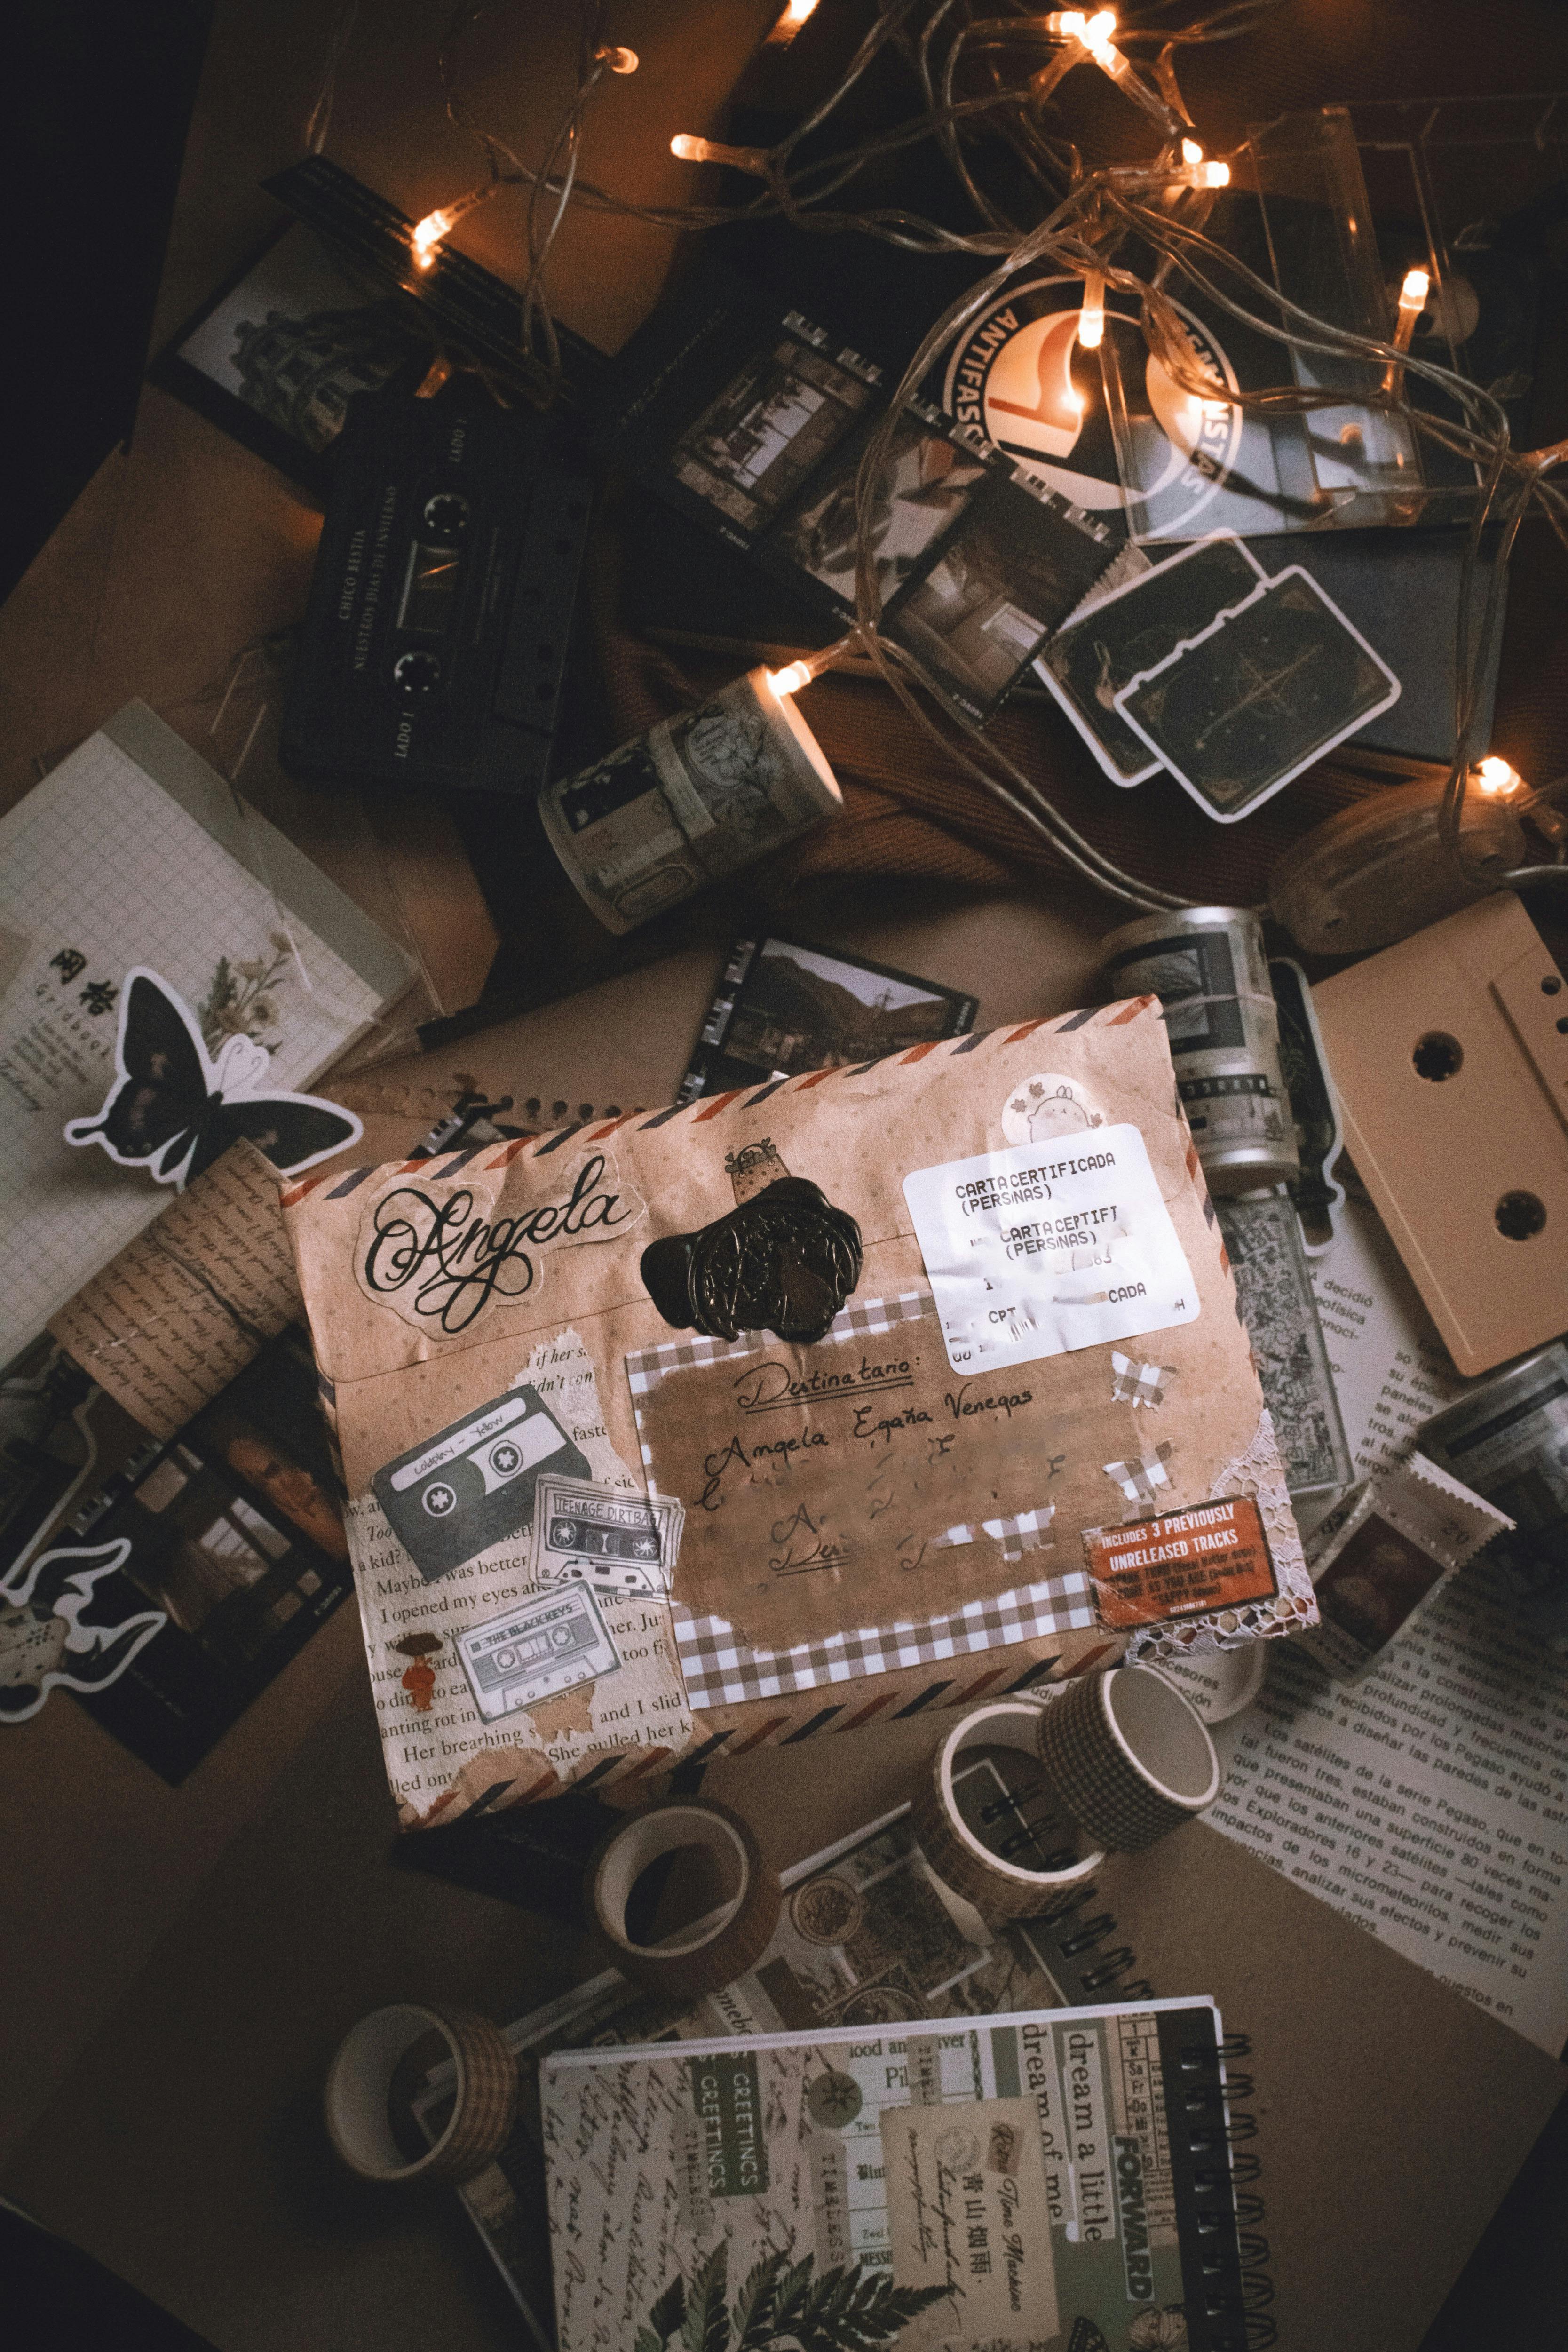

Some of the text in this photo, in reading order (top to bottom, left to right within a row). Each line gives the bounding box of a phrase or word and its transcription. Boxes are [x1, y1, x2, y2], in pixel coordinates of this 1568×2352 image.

[954, 1151, 1116, 1200] CARTA CERTIFICADA
[364, 1154, 632, 1335] Angela
[999, 1219, 1053, 1245] CARTA
[1108, 1282, 1147, 1303] CADA
[547, 1344, 576, 1364] her
[1379, 1384, 1435, 1414] paneles
[704, 1427, 829, 1478] Angela
[366, 1522, 393, 1542] Too
[554, 1496, 605, 1518] TEENAGE
[1101, 1503, 1236, 1549] INCLUDES 3 PREVIOUSLY
[369, 1549, 402, 1570] kid?
[445, 1565, 475, 1582] was
[477, 1549, 529, 1576] better
[1109, 1540, 1189, 1572] UNRELEASED
[1192, 1528, 1239, 1553] TRACKS
[391, 1595, 450, 1626] opened
[453, 1594, 478, 1613] my
[481, 1585, 519, 1607] eyes
[622, 1645, 649, 1662] too
[434, 1714, 457, 1729] rot
[598, 1703, 631, 1724] and
[650, 1692, 681, 1711] slid
[1362, 1680, 1568, 1784] profundidad frecuencia de
[1419, 1686, 1507, 1737] prolongadas
[402, 1724, 523, 1764] Her breathing
[548, 1742, 581, 1763] She
[646, 1721, 676, 1740] her
[1335, 1690, 1553, 1799] recibidos por los Pegaso ayudó
[1352, 1718, 1540, 1812] diseñar las paredes de las
[1239, 1733, 1260, 1751] tal
[1264, 1744, 1310, 1774] fueron
[1350, 1781, 1408, 1818] estaban
[1411, 1809, 1494, 1856] construidos
[1496, 1849, 1517, 1866] en
[1521, 1859, 1563, 1887] forma
[1262, 1723, 1290, 1744] Los
[1292, 1734, 1353, 1772] satélites
[1354, 1764, 1375, 1781] de
[1378, 1774, 1393, 1789] la
[1395, 1781, 1433, 1808] serie
[1493, 1827, 1524, 1850] que
[1526, 1841, 1545, 1858] en
[1225, 1771, 1248, 1790] yor
[1253, 1783, 1283, 1806] que
[1287, 1797, 1310, 1816] los
[1313, 1809, 1385, 1851] anteriores
[1390, 1842, 1449, 1879] satélites
[1508, 1897, 1550, 1924] como
[1231, 1752, 1556, 1906] que presentaban una superficie 80 veces ma-
[1209, 1805, 1275, 1846] impactos
[1281, 1837, 1302, 1855] de
[1308, 1849, 1332, 1868] los
[1460, 1918, 1504, 1946] medir
[1509, 1941, 1536, 1961] sus
[1244, 1799, 1338, 1852] Exploradores
[1344, 1843, 1362, 1860] 16
[1420, 1878, 1455, 1904] para
[1458, 1896, 1514, 1932] recoger
[1520, 1923, 1543, 1942] los
[1291, 1863, 1348, 1899] analizar
[1350, 1890, 1377, 1911] sus
[1379, 1903, 1432, 1936] efectos
[1446, 1934, 1507, 1971] prevenir
[1509, 1963, 1528, 1979] su
[1022, 2023, 1053, 2119] dream
[699, 2075, 727, 2190] GREETINGS
[732, 2072, 759, 2187] GREETINGS
[1069, 2033, 1110, 2242] dream a little
[1114, 2135, 1154, 2302] FORWARD
